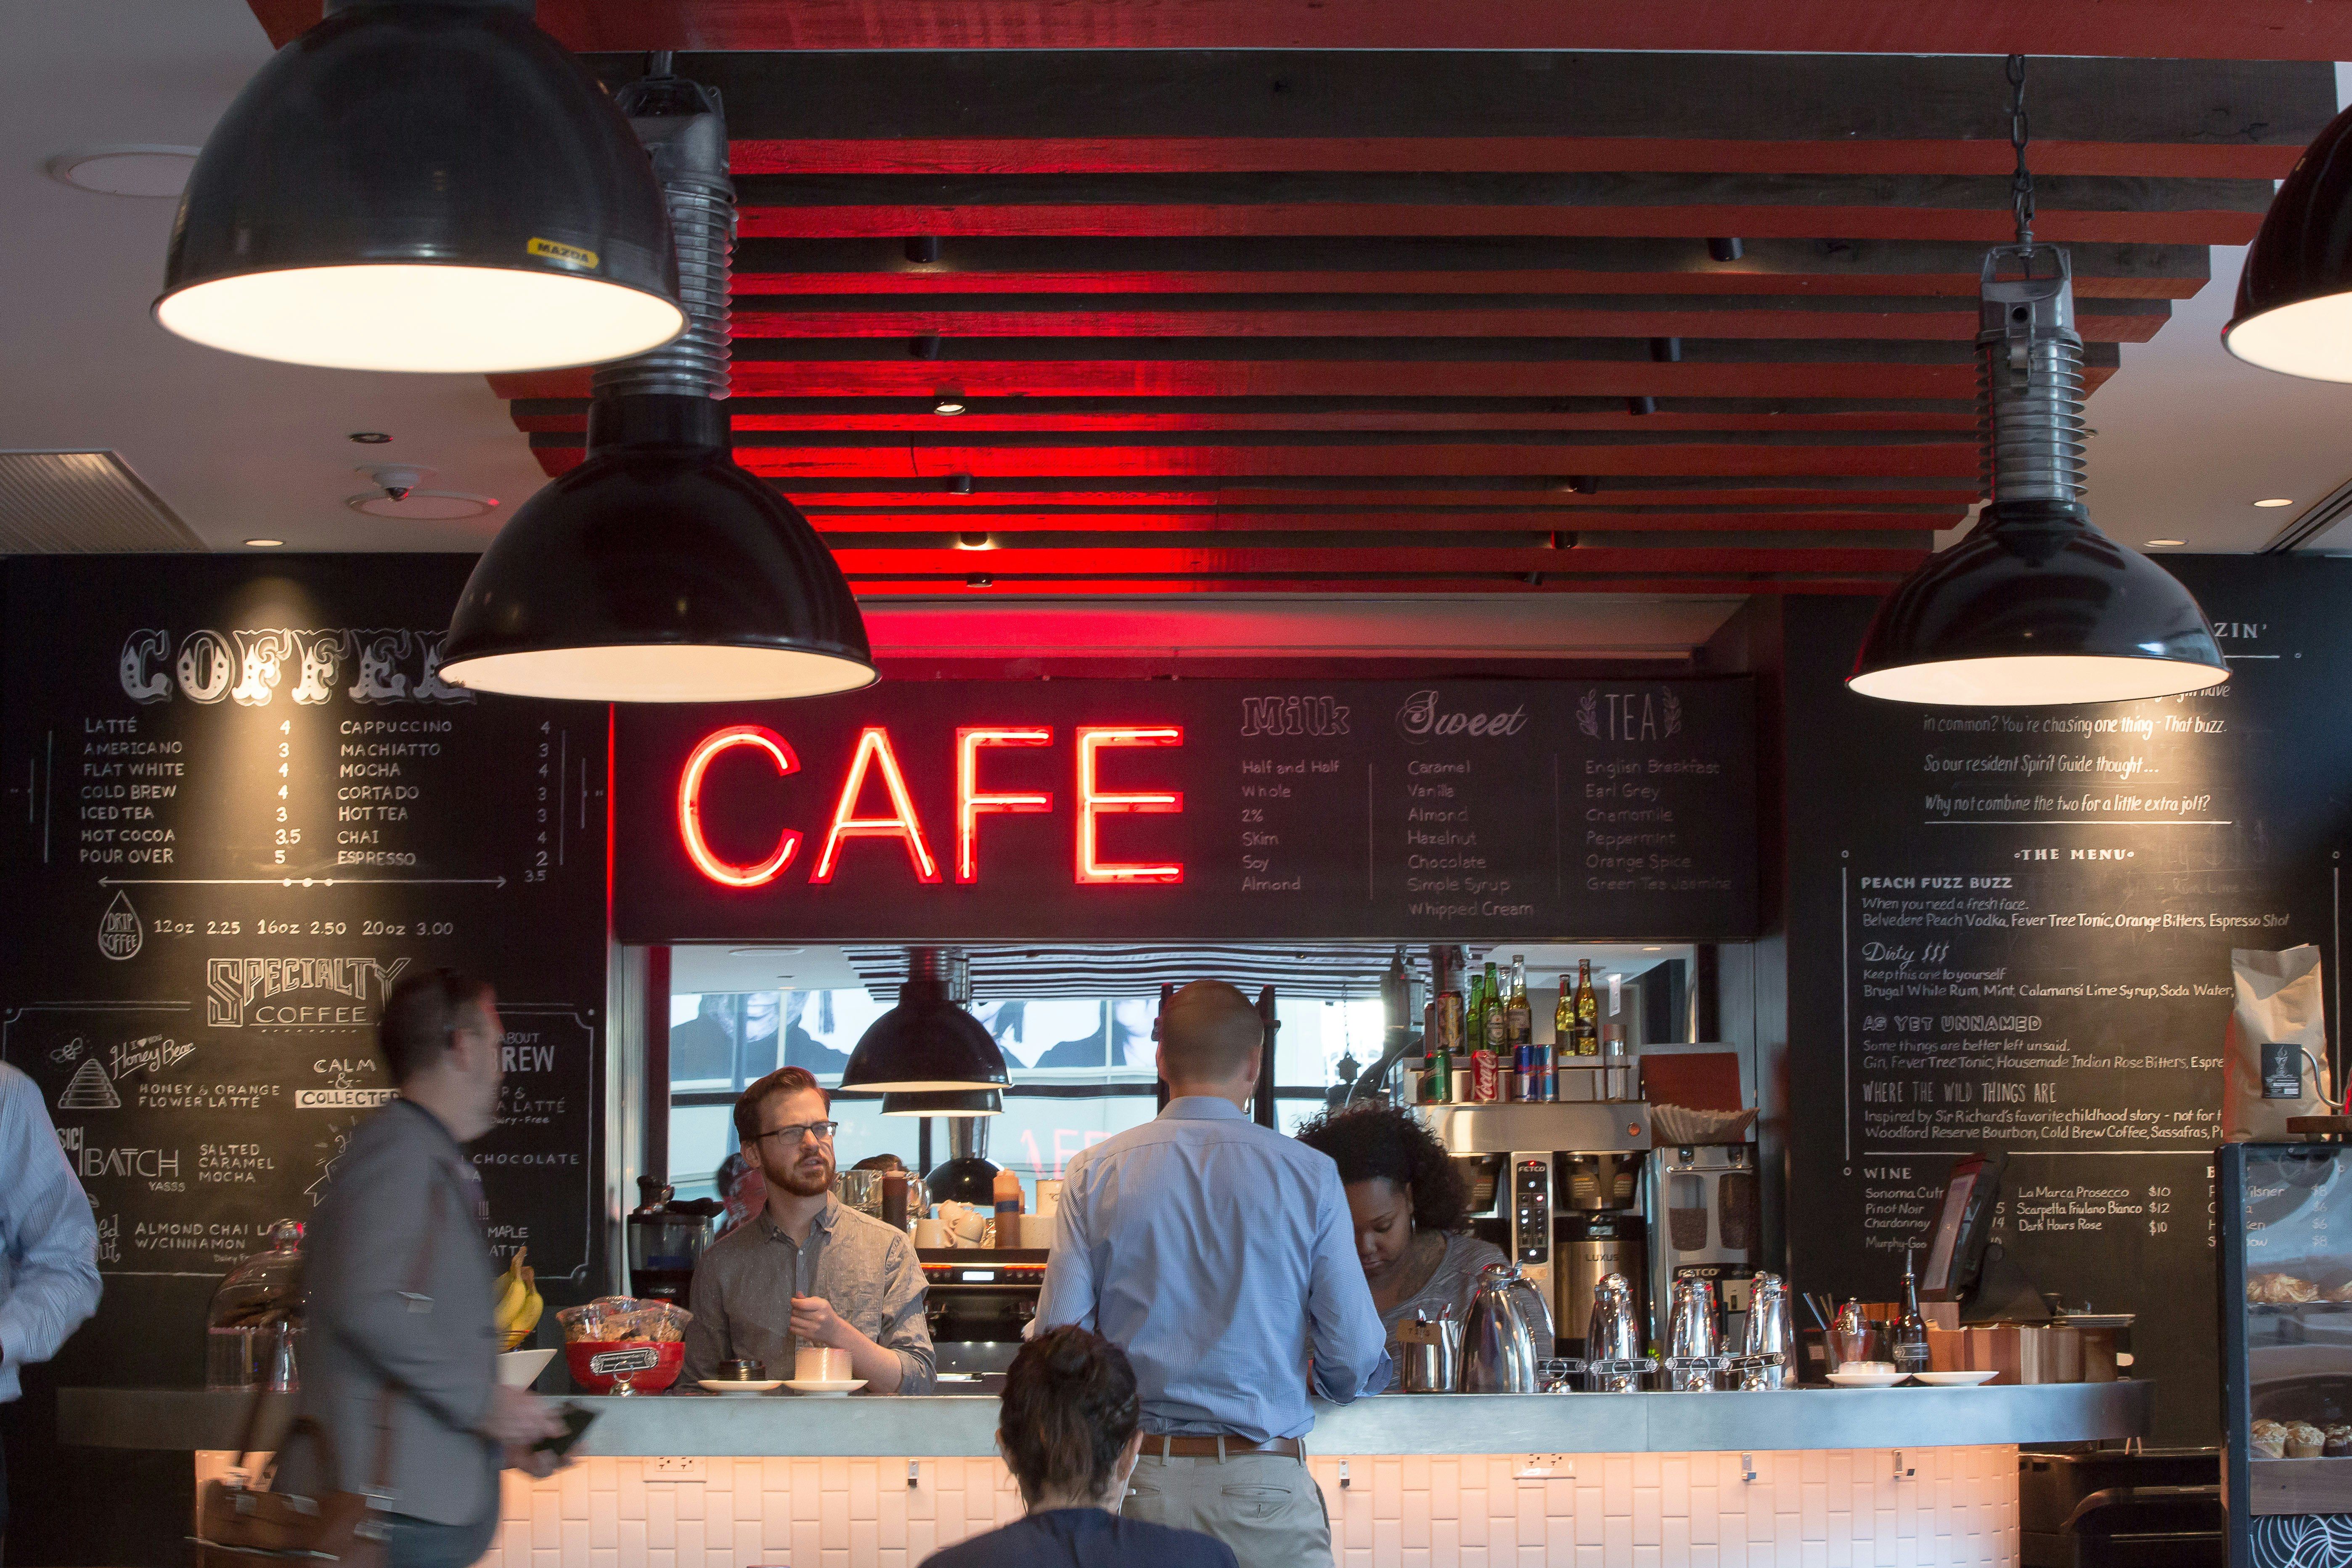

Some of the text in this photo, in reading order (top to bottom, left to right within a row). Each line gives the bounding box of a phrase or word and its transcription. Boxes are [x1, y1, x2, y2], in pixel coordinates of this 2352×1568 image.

[538, 243, 588, 262] MAZDA
[1240, 696, 1350, 736] Milk
[1396, 690, 1528, 744] Sweet
[1605, 693, 1657, 741] TEA
[280, 720, 291, 735] 4
[339, 720, 452, 734] CAPPUCCINO
[1923, 715, 1935, 731] in
[1937, 715, 1999, 732] common?
[2042, 715, 2092, 739] chasing
[2094, 718, 2118, 733] one
[2121, 715, 2154, 741] thing
[2164, 715, 2193, 733] That
[2194, 716, 2227, 733] buzz.
[85, 742, 183, 755] AMERICANO
[278, 742, 289, 758] 3
[340, 742, 441, 757] MACHIATTO
[84, 763, 184, 776] FLAT WHITE
[278, 763, 289, 778] 4
[339, 763, 401, 778] MOCHA
[1242, 760, 1340, 774] Half and Half
[1408, 760, 1471, 775] Caramel
[1924, 754, 1940, 772] So
[1942, 759, 1964, 772] our
[1965, 754, 2019, 772] resident
[2021, 754, 2055, 777] Spirit
[2057, 754, 2092, 772] Guide
[82, 784, 177, 800] COLD BREW
[278, 784, 288, 800] 4
[337, 786, 419, 800] CORTADO
[1241, 785, 1291, 798] Whole
[1407, 784, 1455, 798] Vanilla
[81, 806, 154, 820] ICED TEA
[678, 725, 1184, 887] CAFE
[1925, 794, 2211, 817] Why not combine the two for a little extra jolt?
[276, 806, 288, 822] 3
[338, 806, 408, 821] HOT TEA
[1242, 809, 1263, 822] 2%
[1407, 807, 1468, 822] Almond
[81, 829, 176, 842] HOT COCOA
[275, 828, 301, 845] 3.5
[337, 830, 379, 844] CHAI
[1242, 832, 1279, 847] Skim
[80, 848, 174, 863] POUR OVER
[274, 850, 286, 864] 5
[337, 850, 416, 866] ESPRESSO
[535, 851, 548, 866] 2
[1408, 853, 1487, 869] Chocolate
[2021, 849, 2126, 861] THE MENU
[1242, 855, 1270, 871] Soy
[1242, 876, 1301, 892] Almond
[1861, 877, 2013, 889] PEACH FUZZ BUZZ
[1408, 901, 1534, 920] Whipped Cream
[207, 921, 241, 936] 2.25
[257, 919, 300, 935] 16oz
[310, 921, 347, 936] 2.50
[416, 922, 453, 936] 3.00
[2048, 913, 2261, 932] Tree Tonic, Orange Bitters, Espresso
[1862, 942, 1915, 968] Dirty
[207, 957, 411, 1028] SPECIALTY
[2119, 984, 2235, 999] Syrup, Soda Water,
[255, 1006, 367, 1023] COFFEE
[1941, 1016, 2042, 1032] UNNAMED
[2026, 1038, 2070, 1051] unsaid.
[109, 1038, 194, 1081] Honey Bear
[313, 1058, 377, 1073] CALM
[2071, 1054, 2189, 1070] Indian Rose Bitters,
[139, 1083, 193, 1094] HONEY
[215, 1085, 280, 1096] ORANGE
[1862, 1081, 2057, 1103] WHERE THE WILD THINGS ARE
[139, 1095, 260, 1108] FLOWER LATTÉ
[2065, 1107, 2214, 1124] childhood story for
[2072, 1126, 2209, 1140] Brew Coffee, Sassafras,
[199, 1144, 260, 1156] SALTED
[85, 1148, 179, 1177] BATCH
[198, 1157, 275, 1170] CARAMEL
[473, 1154, 580, 1165] CHOCOLATE
[198, 1171, 256, 1184] MOCHA
[1863, 1167, 1912, 1179] WINE
[2018, 1184, 2171, 1198] La Marca Prosecco $10
[2017, 1200, 2170, 1222] Scarpetta Friulano Bianco $12
[135, 1222, 204, 1236] ALMOND
[209, 1224, 248, 1236] CHAI
[487, 1225, 529, 1238] MAPLE
[2019, 1218, 2168, 1236] Dark Hours Rose $10
[135, 1237, 246, 1250] W/CINNAMON
